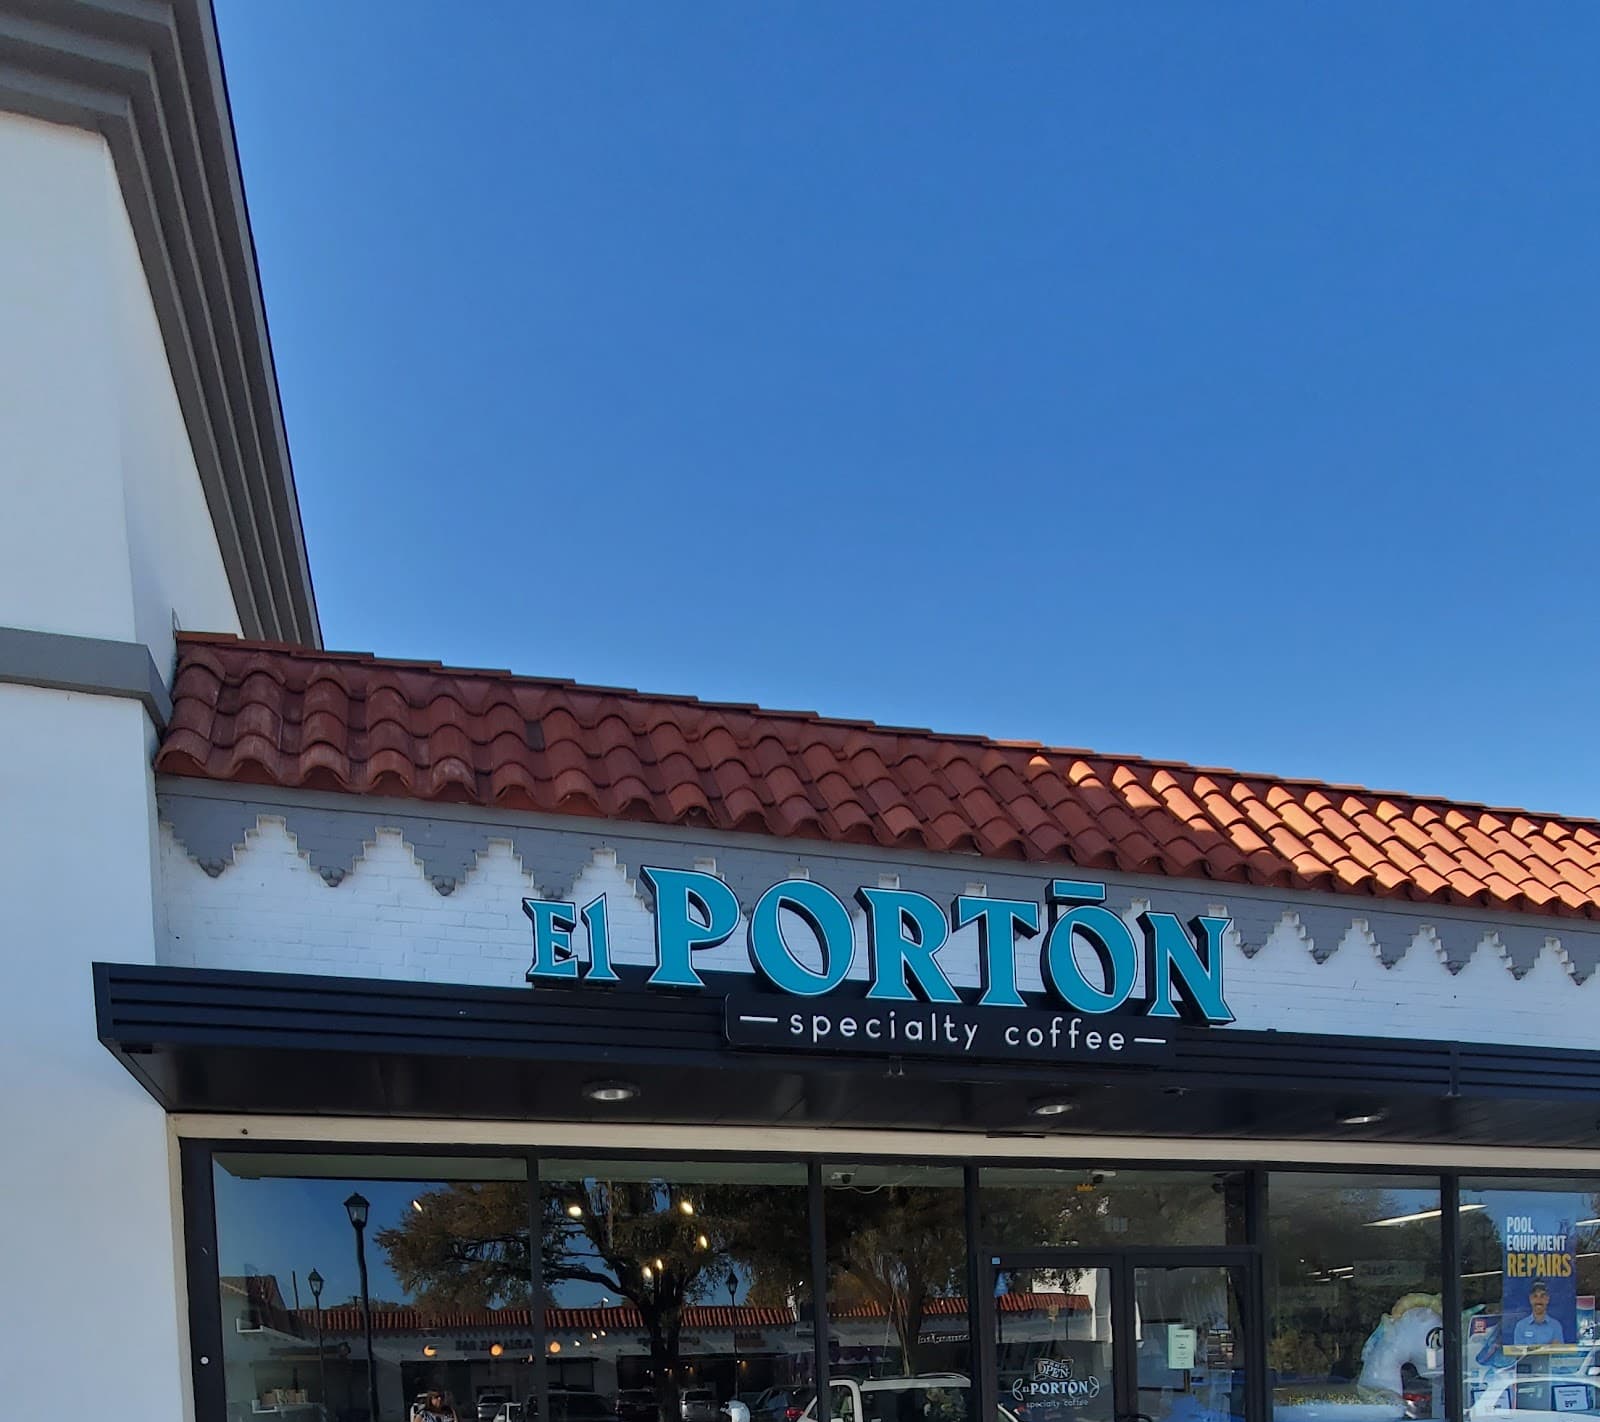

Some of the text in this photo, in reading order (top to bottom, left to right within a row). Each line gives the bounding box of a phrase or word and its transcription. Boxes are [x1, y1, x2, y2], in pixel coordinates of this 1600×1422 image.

[790, 1010, 1126, 1051] specialty coffee
[1507, 1216, 1534, 1233] POOL
[1507, 1235, 1567, 1252] EQUIPMENT
[1507, 1253, 1572, 1277] REPAIRS
[1037, 1361, 1070, 1378] OPEN
